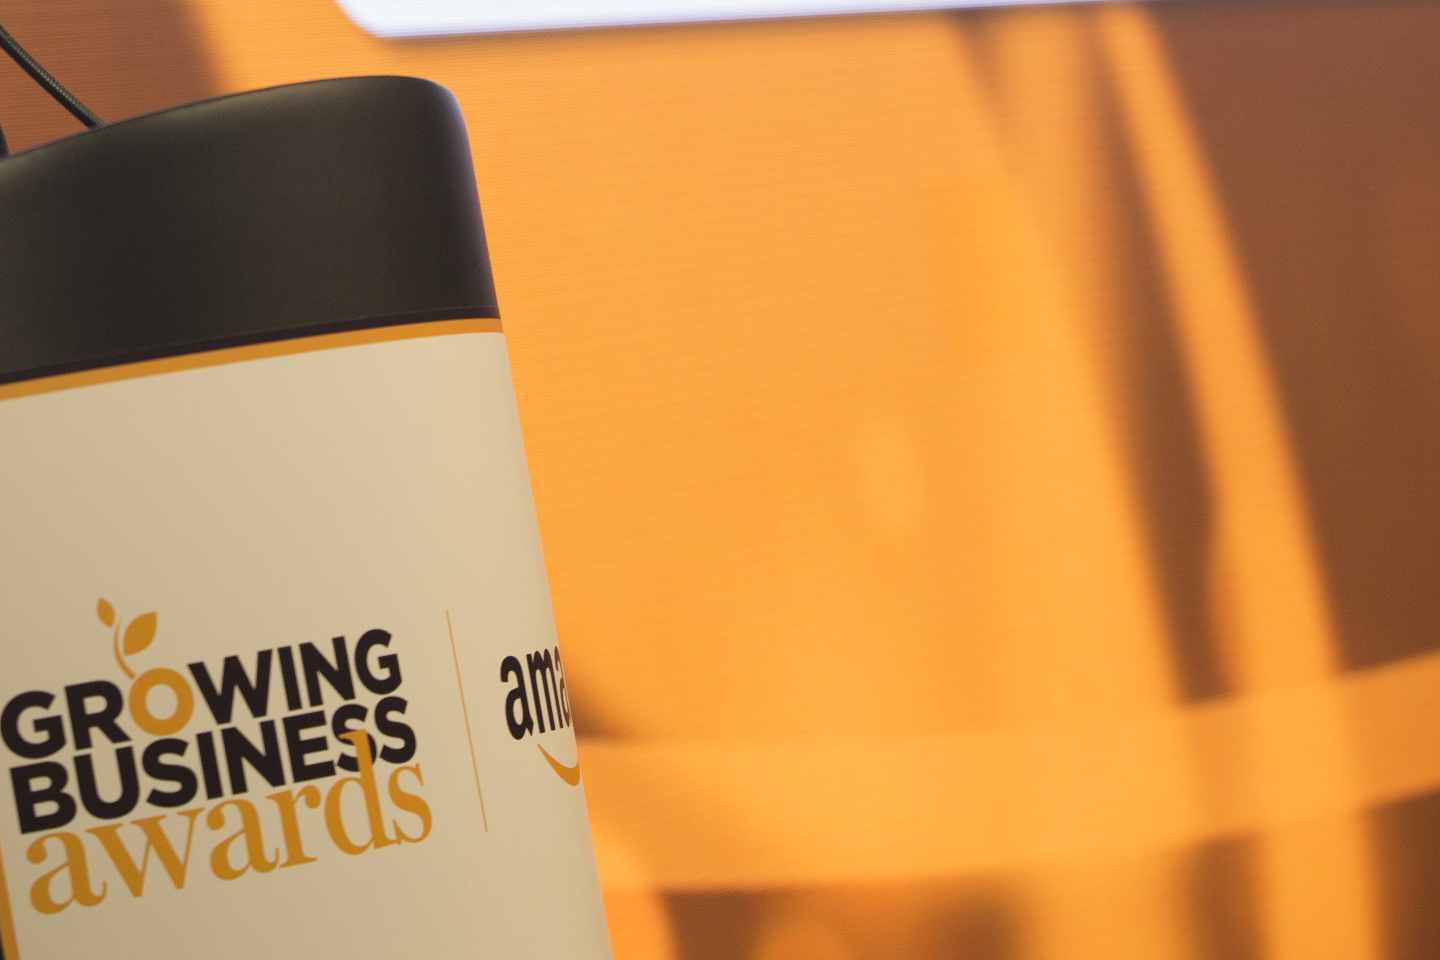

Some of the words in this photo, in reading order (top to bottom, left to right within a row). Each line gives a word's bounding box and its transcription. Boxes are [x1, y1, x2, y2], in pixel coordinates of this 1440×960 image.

[0, 628, 403, 760] GROWING
[9, 696, 417, 835] BUSINESS
[23, 730, 433, 916] awards
